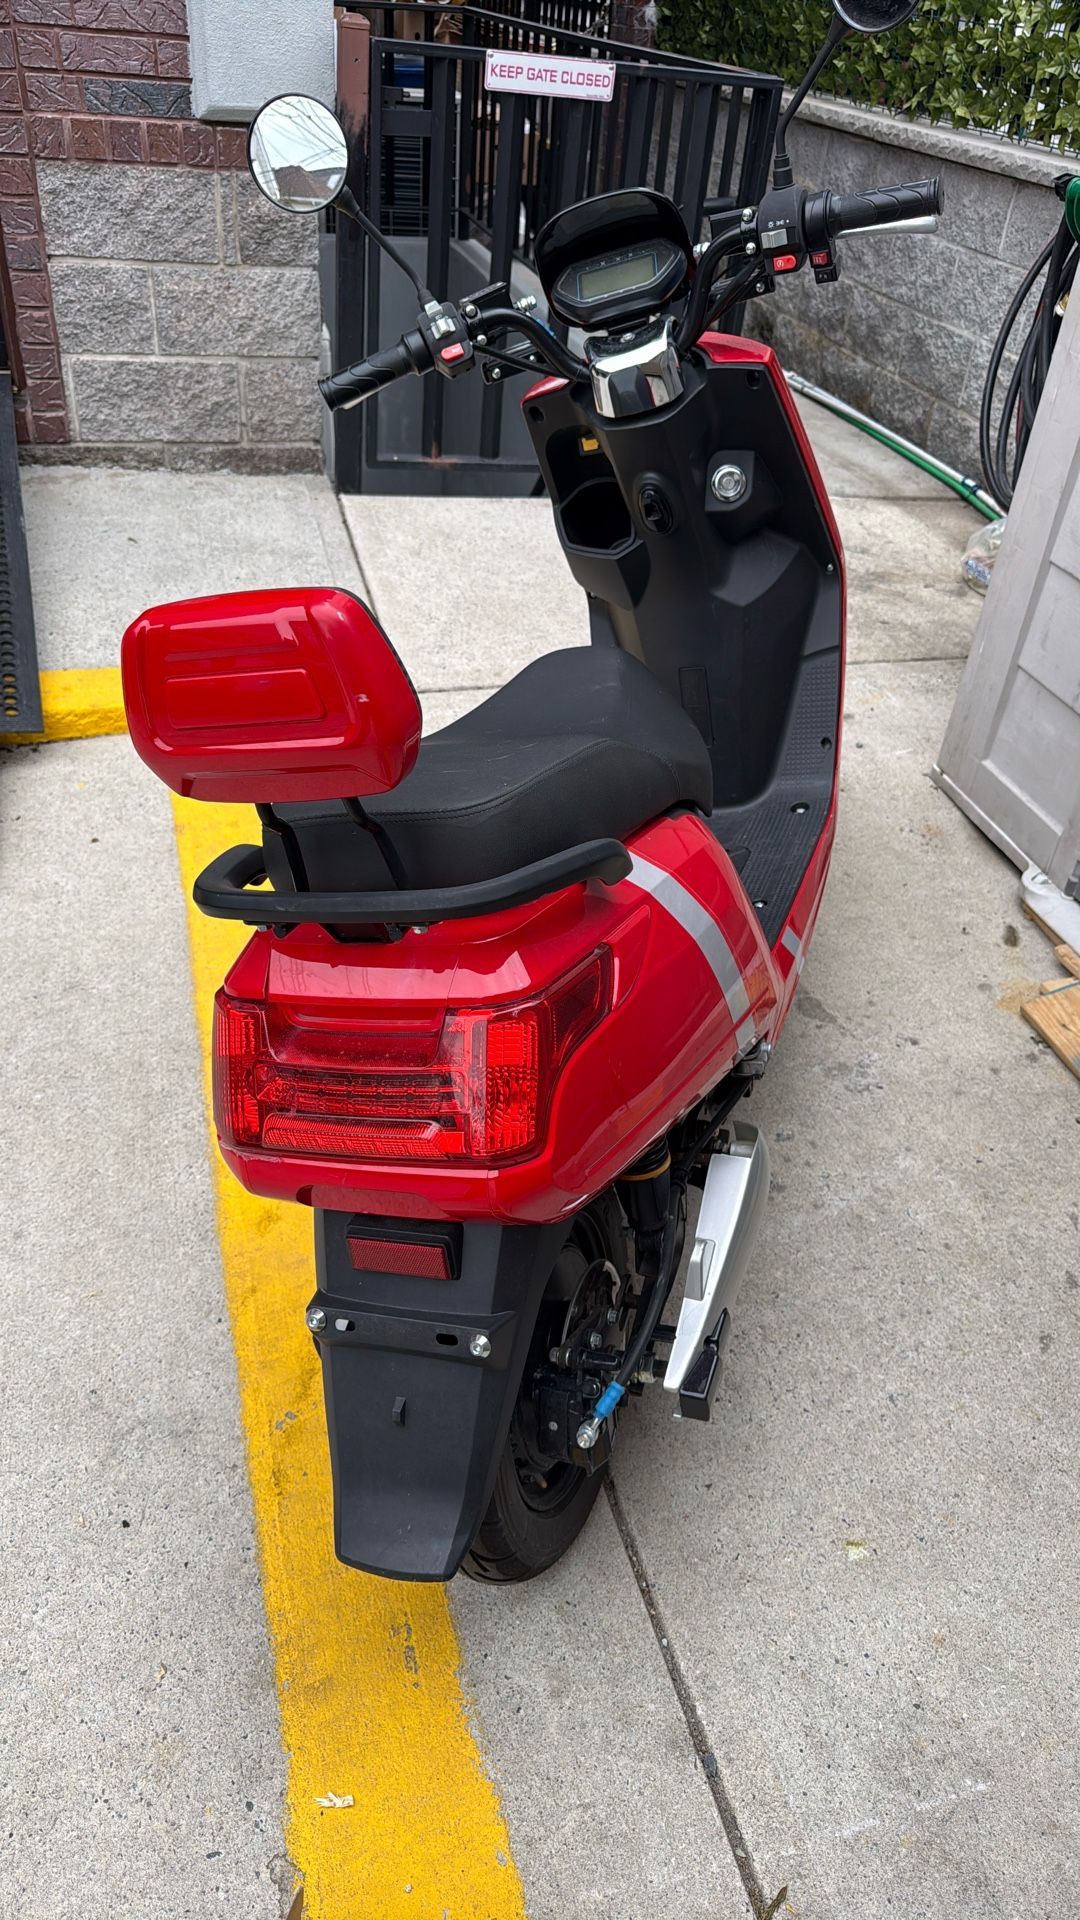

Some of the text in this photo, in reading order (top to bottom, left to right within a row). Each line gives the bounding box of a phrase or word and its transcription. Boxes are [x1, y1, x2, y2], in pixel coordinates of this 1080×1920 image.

[490, 64, 610, 88] KEEP GATE CLOSED
